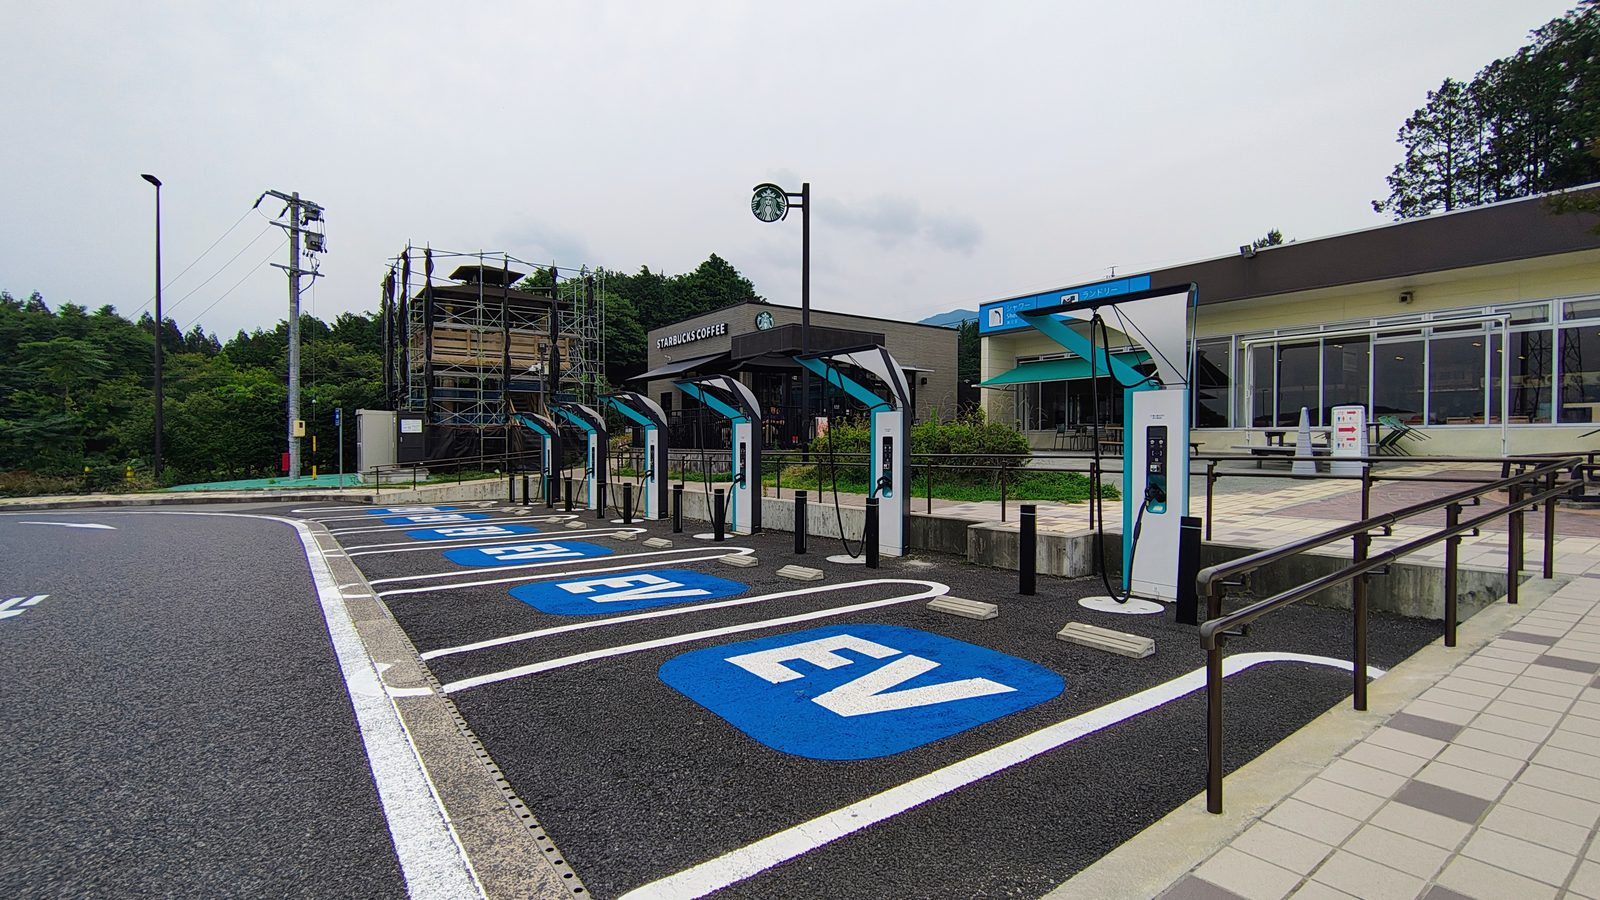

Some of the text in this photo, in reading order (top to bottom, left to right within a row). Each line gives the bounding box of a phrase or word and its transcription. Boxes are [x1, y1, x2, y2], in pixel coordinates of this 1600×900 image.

[1082, 287, 1119, 299] ランドリー
[1006, 302, 1031, 312] シャワー
[656, 323, 726, 349] STARBUCKS COFFEE
[434, 526, 515, 536] EV
[479, 543, 585, 561] EV
[555, 573, 712, 603] EV
[724, 634, 1018, 718] EV
